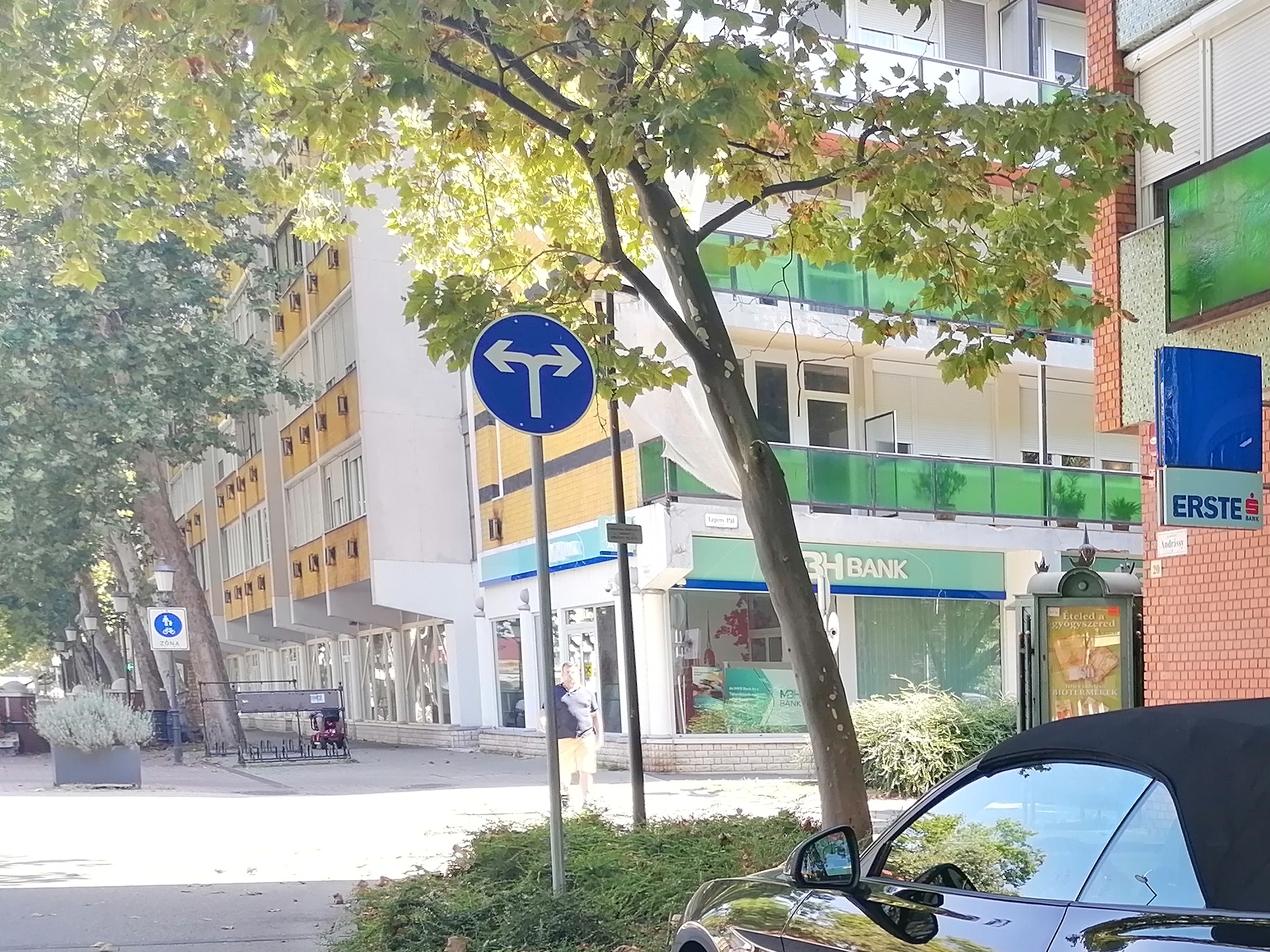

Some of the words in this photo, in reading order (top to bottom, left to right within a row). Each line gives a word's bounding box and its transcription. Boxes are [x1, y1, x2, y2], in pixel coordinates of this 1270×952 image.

[1172, 494, 1243, 520] ERSTE
[801, 551, 844, 580] BH
[847, 557, 908, 579] BANK
[1063, 610, 1095, 620] Ételed
[1051, 619, 1116, 630] gyógyszered
